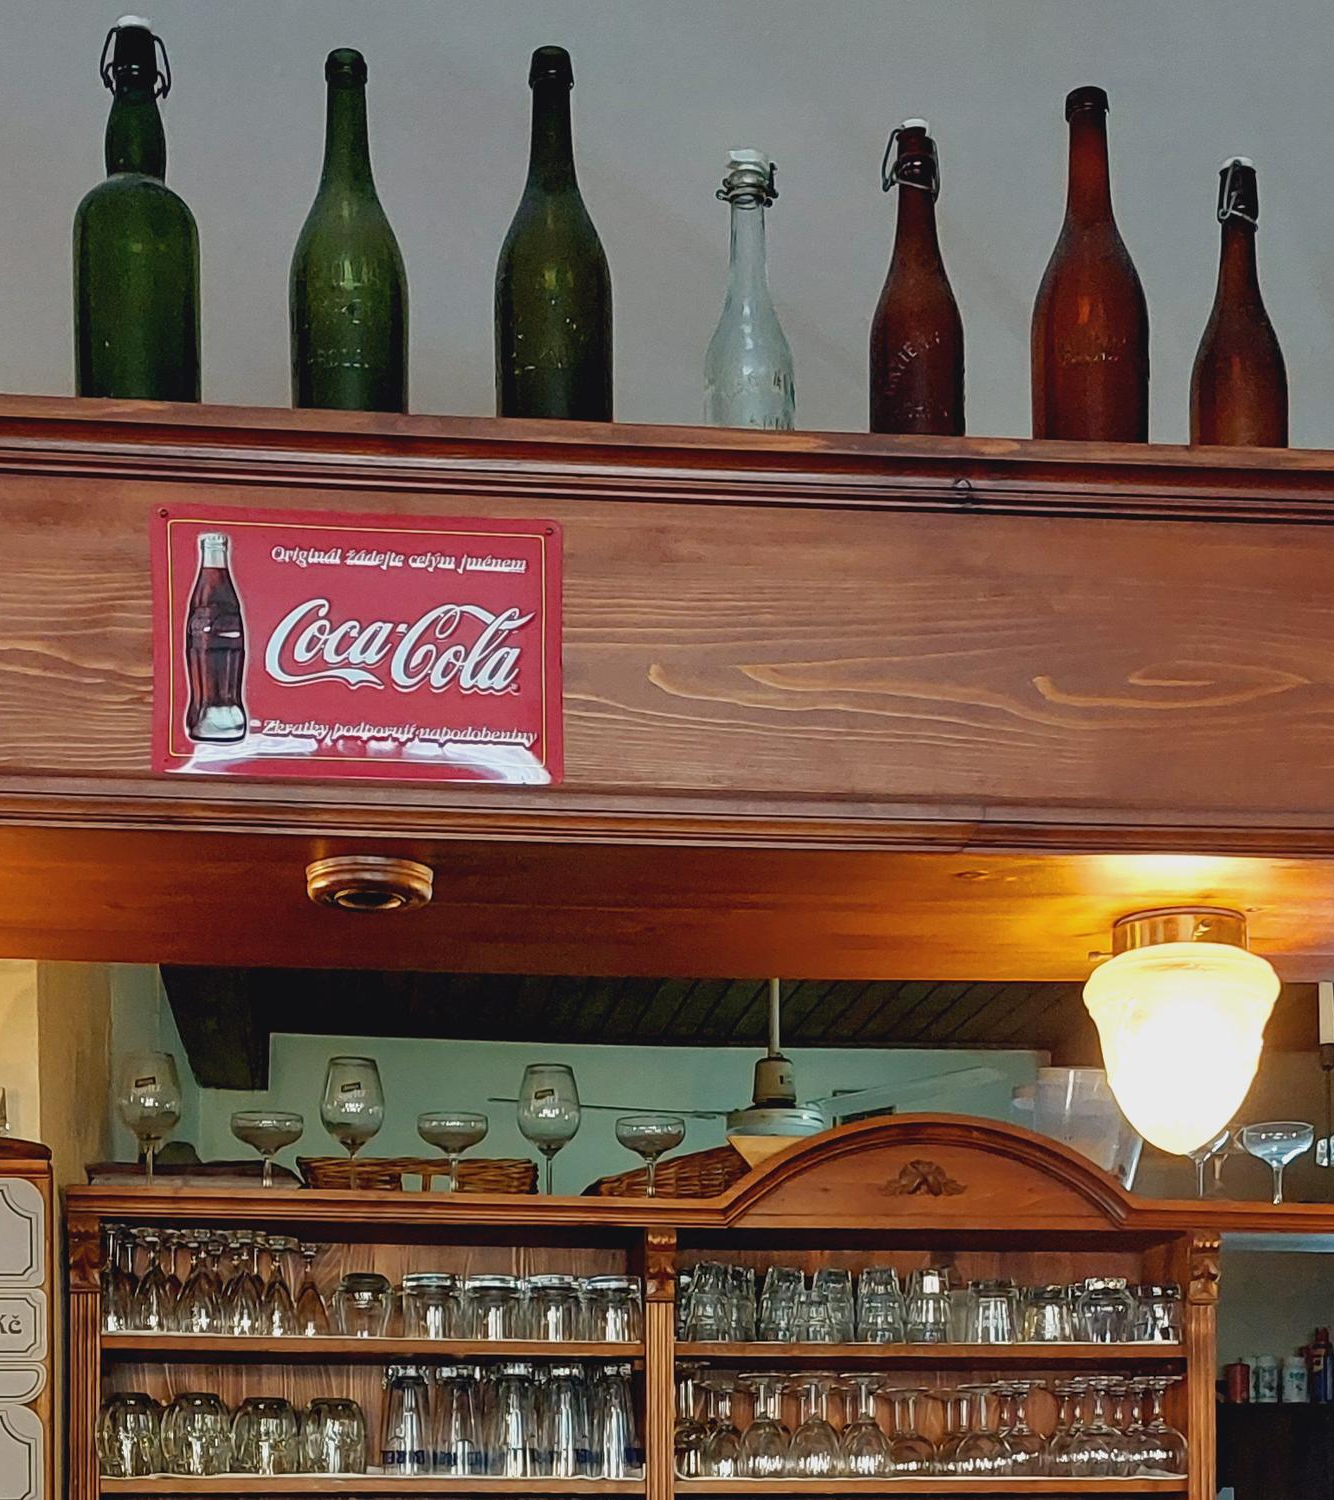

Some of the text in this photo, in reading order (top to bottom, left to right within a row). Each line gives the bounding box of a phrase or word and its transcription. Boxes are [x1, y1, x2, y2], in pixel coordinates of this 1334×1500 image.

[271, 546, 527, 574] Originál žádejte celým jménem
[265, 599, 535, 694] Coca-Cola
[263, 719, 537, 747] Zkratky podporují napodobeniny
